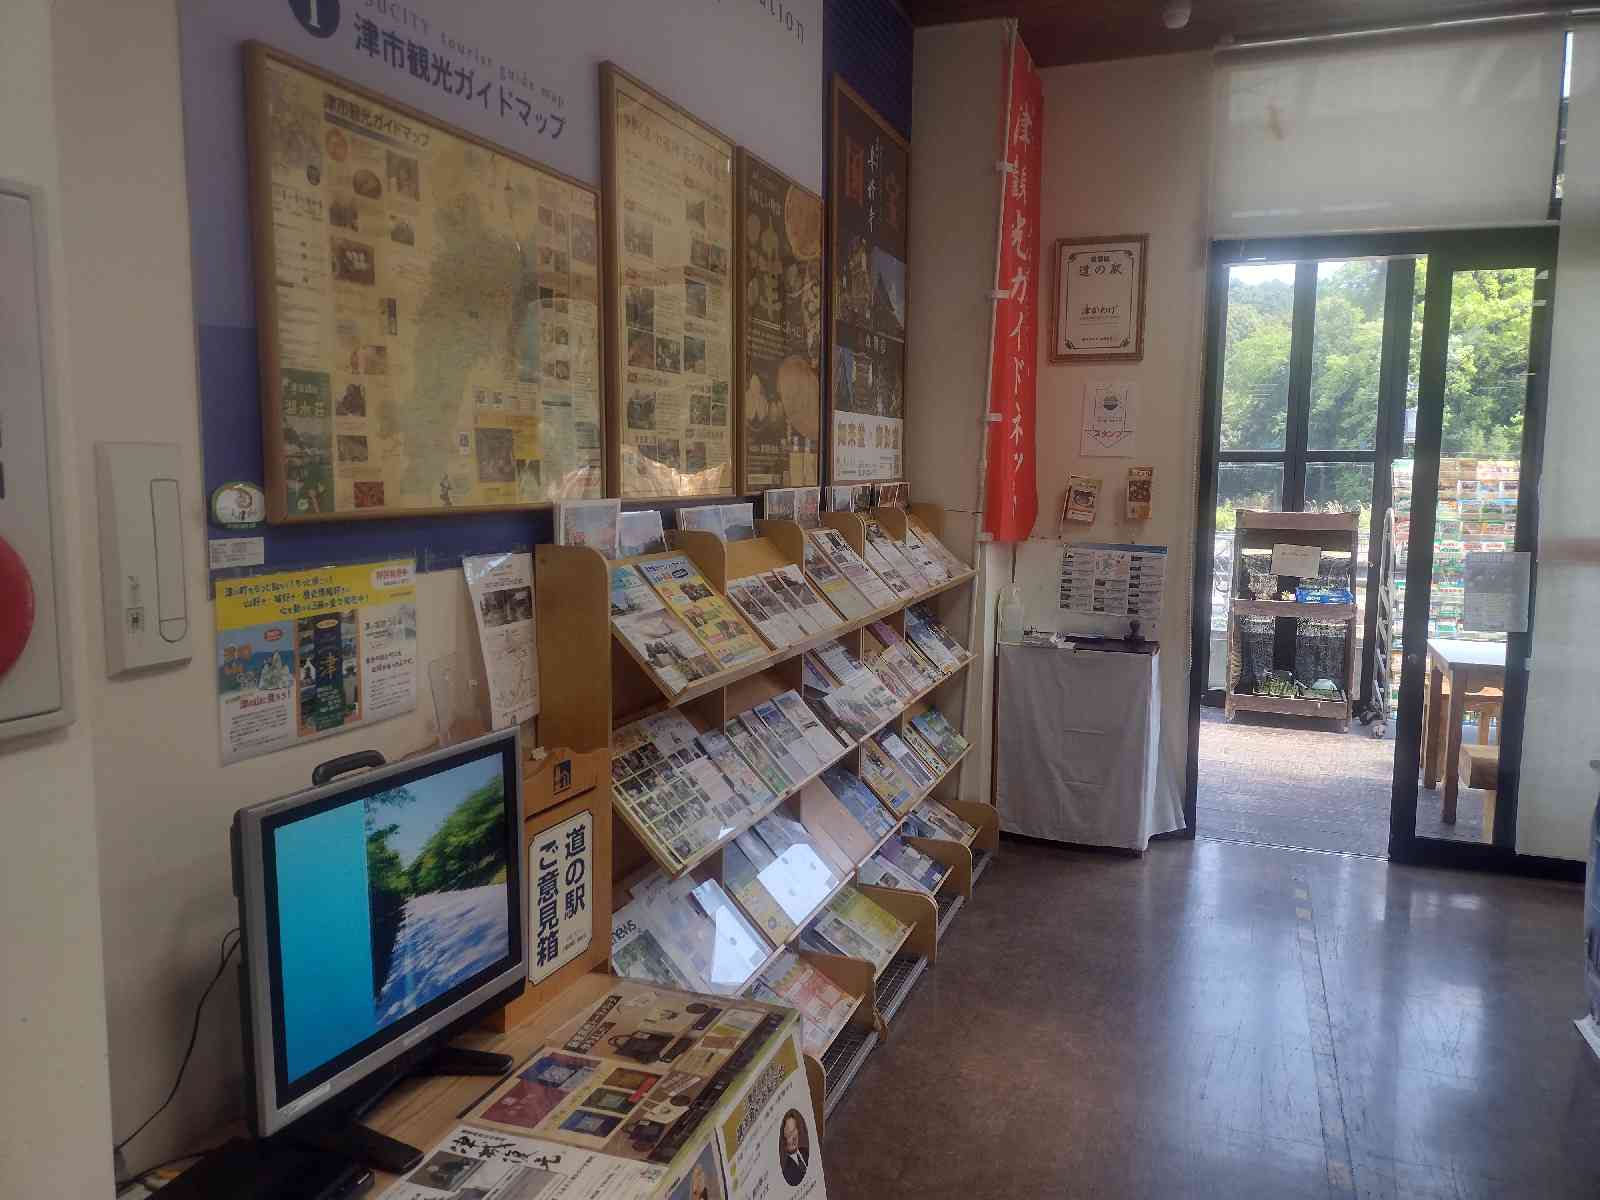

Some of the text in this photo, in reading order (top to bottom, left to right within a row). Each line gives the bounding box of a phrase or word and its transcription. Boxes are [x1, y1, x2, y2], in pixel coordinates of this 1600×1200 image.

[353, 12, 567, 139] 津市観光ガイドマップ
[536, 839, 560, 968] ご意見箱
[564, 824, 586, 921] 道の駅
